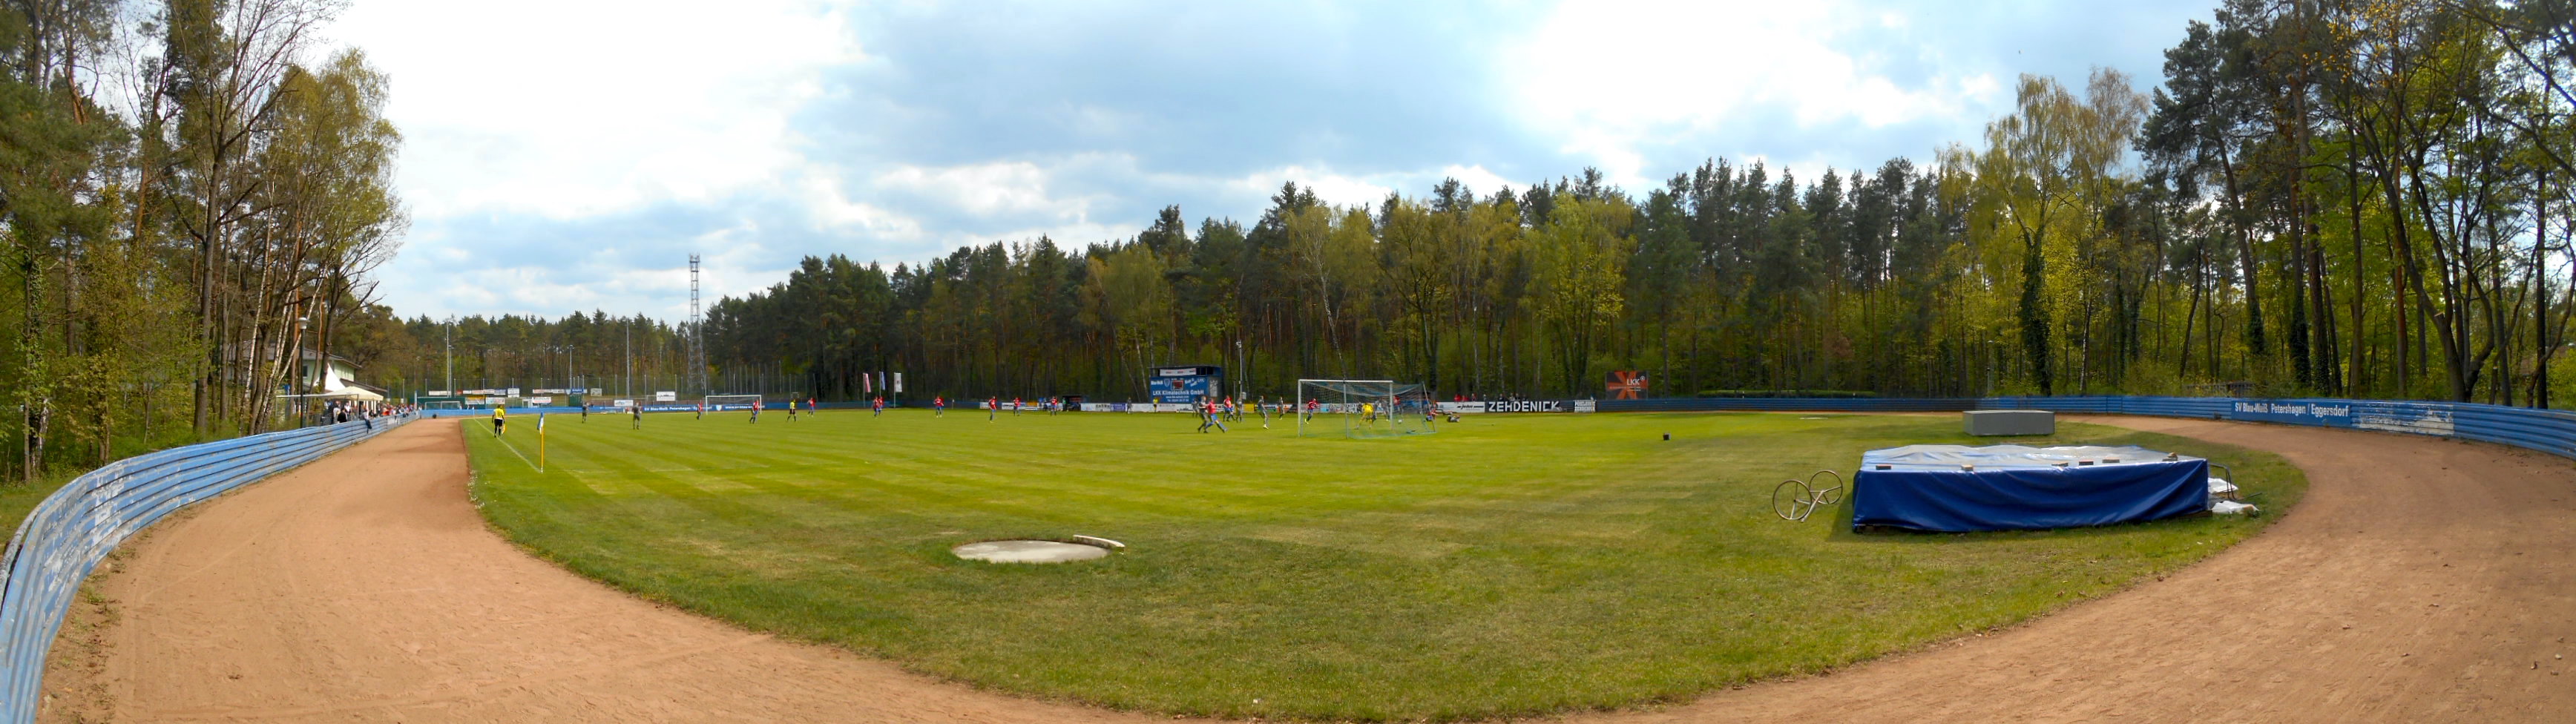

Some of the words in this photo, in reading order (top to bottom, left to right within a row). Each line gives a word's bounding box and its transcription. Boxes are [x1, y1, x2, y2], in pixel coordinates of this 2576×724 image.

[1488, 401, 1560, 412] ZEHDENICK
[2235, 402, 2243, 412] SV
[2243, 403, 2268, 413] Blau-Weiß
[2271, 403, 2306, 416] Petershagen
[2311, 404, 2349, 418] Eggersdorf
